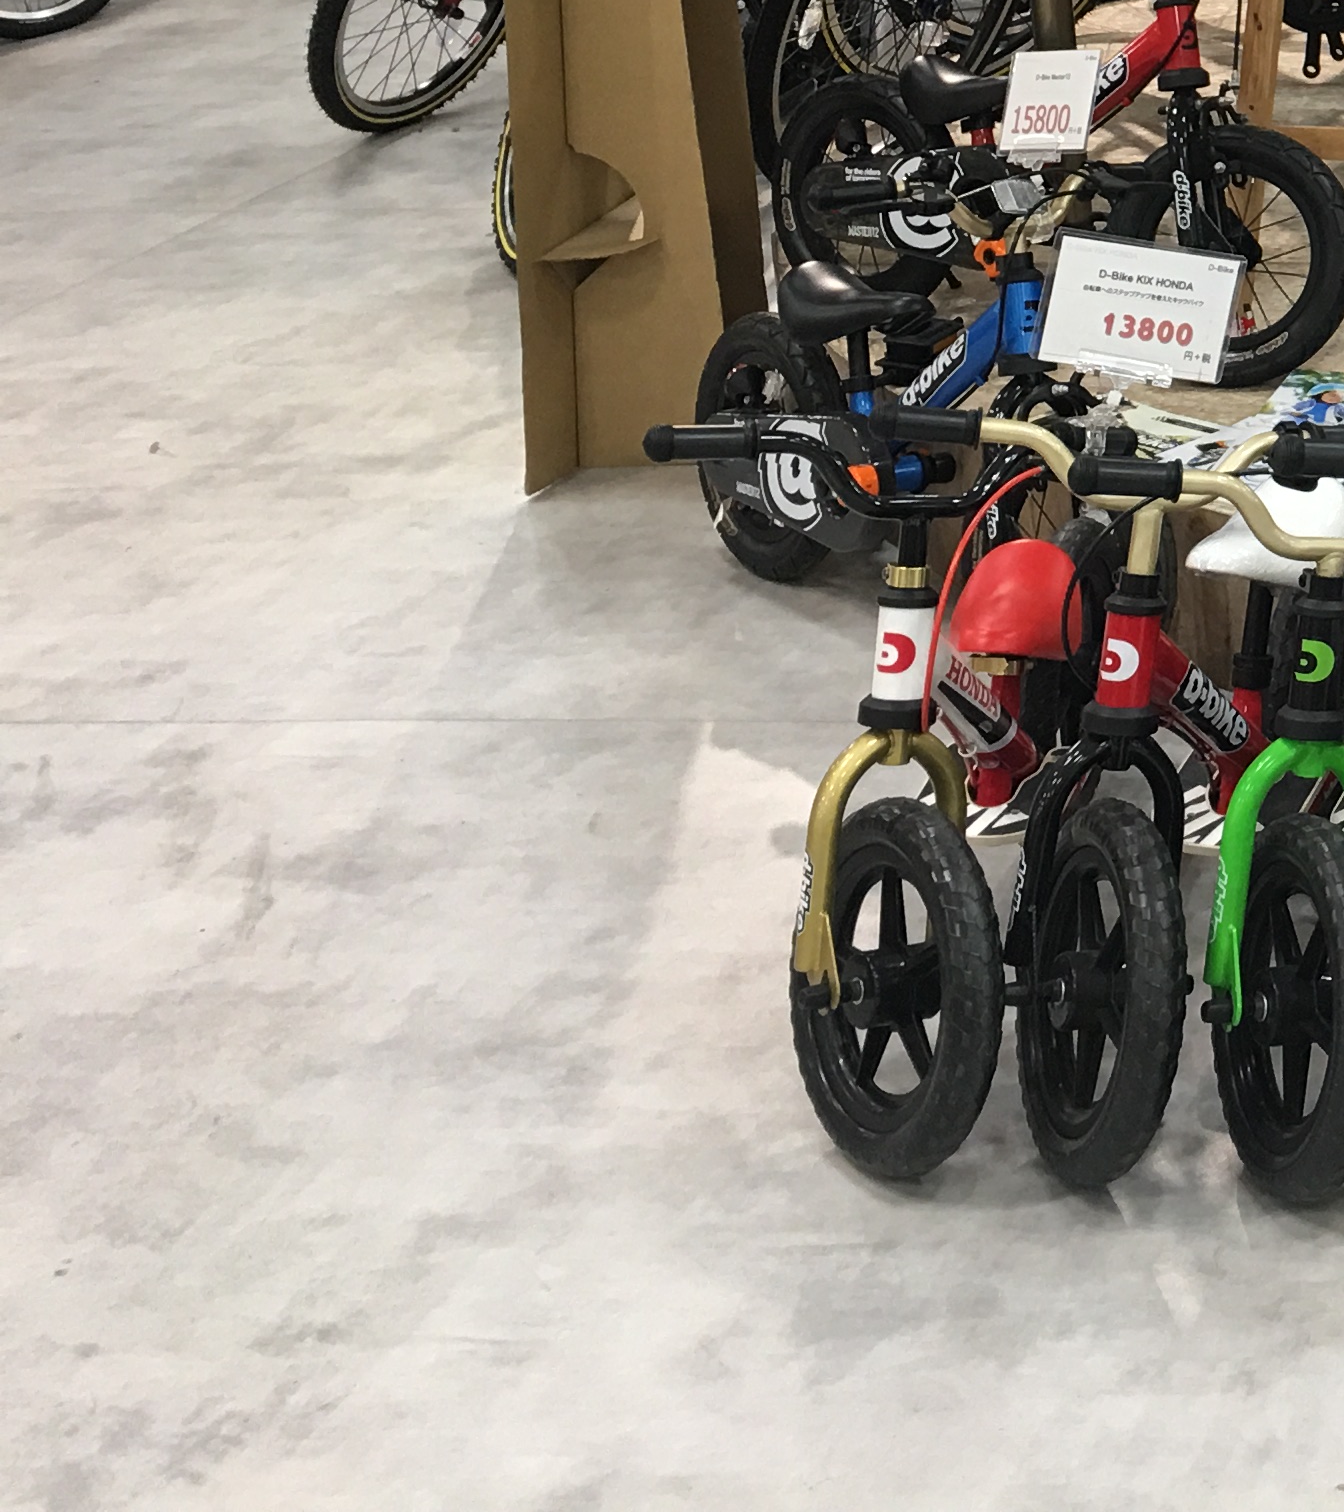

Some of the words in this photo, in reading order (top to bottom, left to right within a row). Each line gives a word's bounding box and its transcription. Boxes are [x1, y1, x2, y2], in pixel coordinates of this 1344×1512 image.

[1011, 104, 1071, 134] 15800
[1208, 263, 1234, 273] D-Bike
[1099, 269, 1134, 284] D-Bike
[1136, 273, 1154, 286] KIX
[1156, 276, 1194, 292] HONDA
[1104, 312, 1193, 347] 13800
[1183, 350, 1211, 364] 円+税
